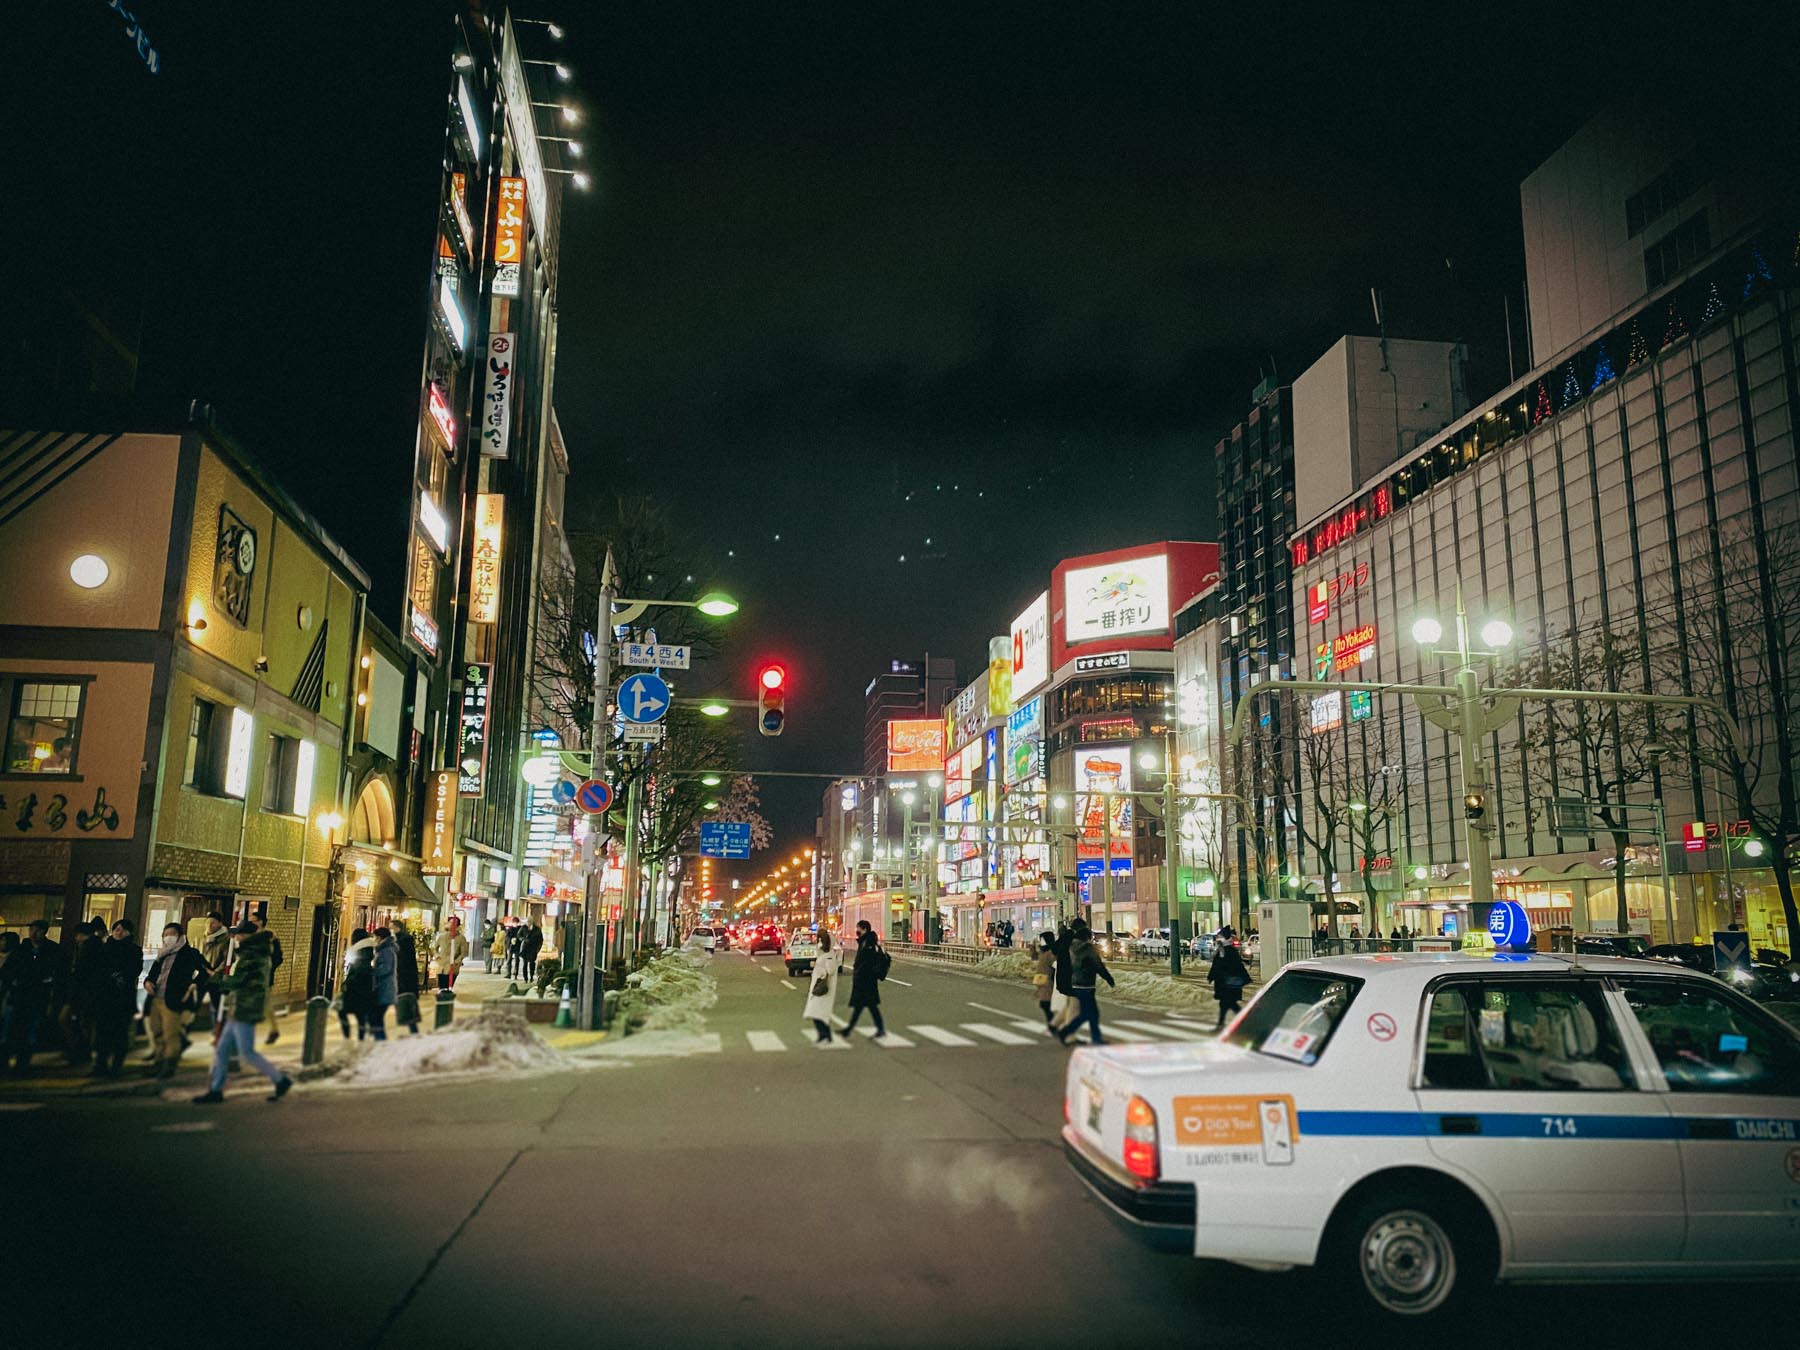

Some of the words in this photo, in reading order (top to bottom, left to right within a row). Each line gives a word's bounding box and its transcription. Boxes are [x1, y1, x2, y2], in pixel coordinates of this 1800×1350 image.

[499, 202, 521, 259] ふう
[493, 339, 508, 351] 2F
[1328, 562, 1368, 601] ラフィラ
[475, 612, 488, 620] 4F
[1085, 605, 1151, 629] 一番搾り
[629, 645, 685, 660] 南4西4
[629, 656, 649, 664] South
[660, 658, 677, 666] West
[432, 773, 449, 858] OSTERIA
[1490, 909, 1506, 937] 第一
[1541, 1118, 1577, 1136] 714
[1736, 1120, 1796, 1139] DAIICHI
